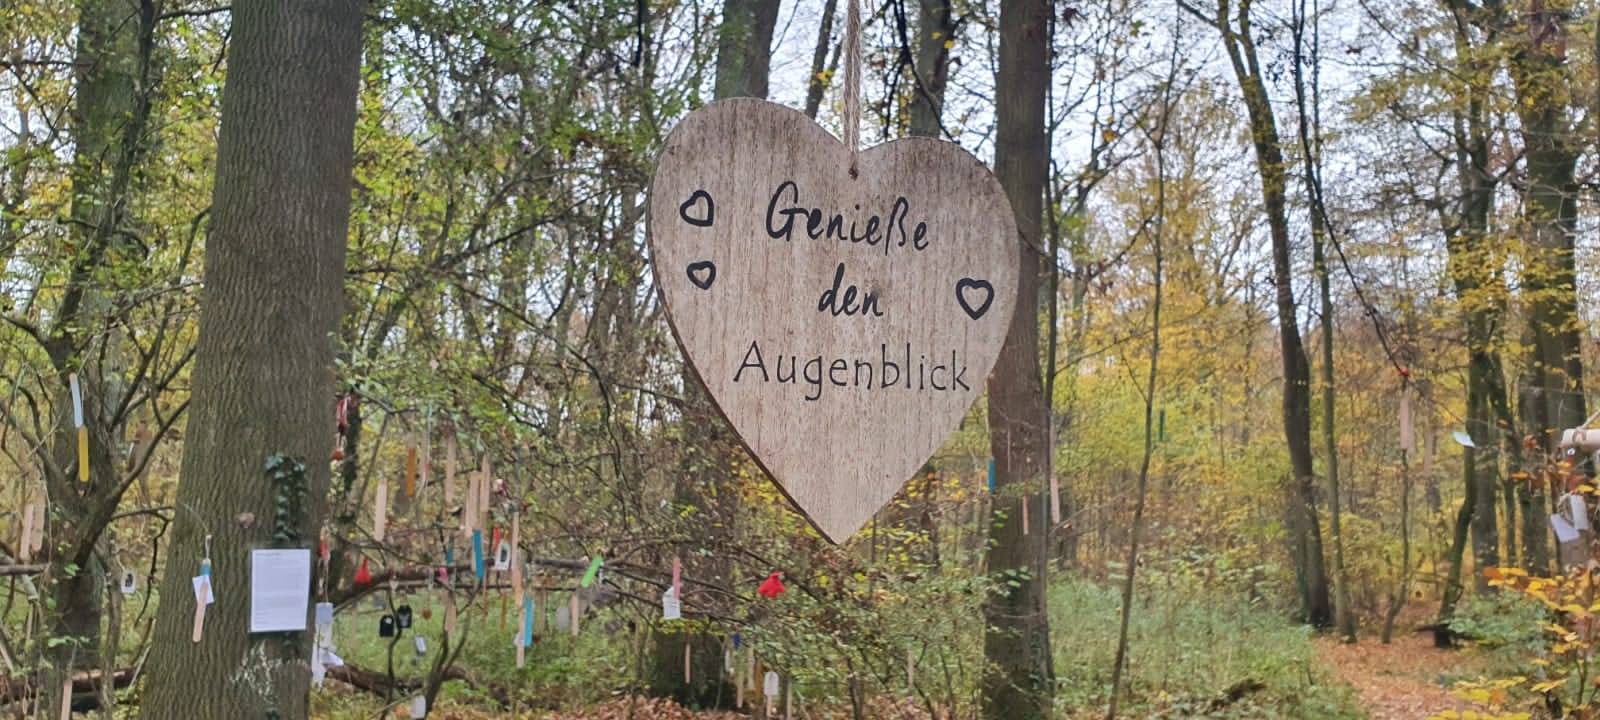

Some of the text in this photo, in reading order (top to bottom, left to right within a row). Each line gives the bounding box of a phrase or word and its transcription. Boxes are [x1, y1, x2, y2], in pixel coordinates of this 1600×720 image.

[766, 181, 929, 256] Genieße
[818, 263, 884, 316] den
[733, 340, 971, 401] Augenblick
